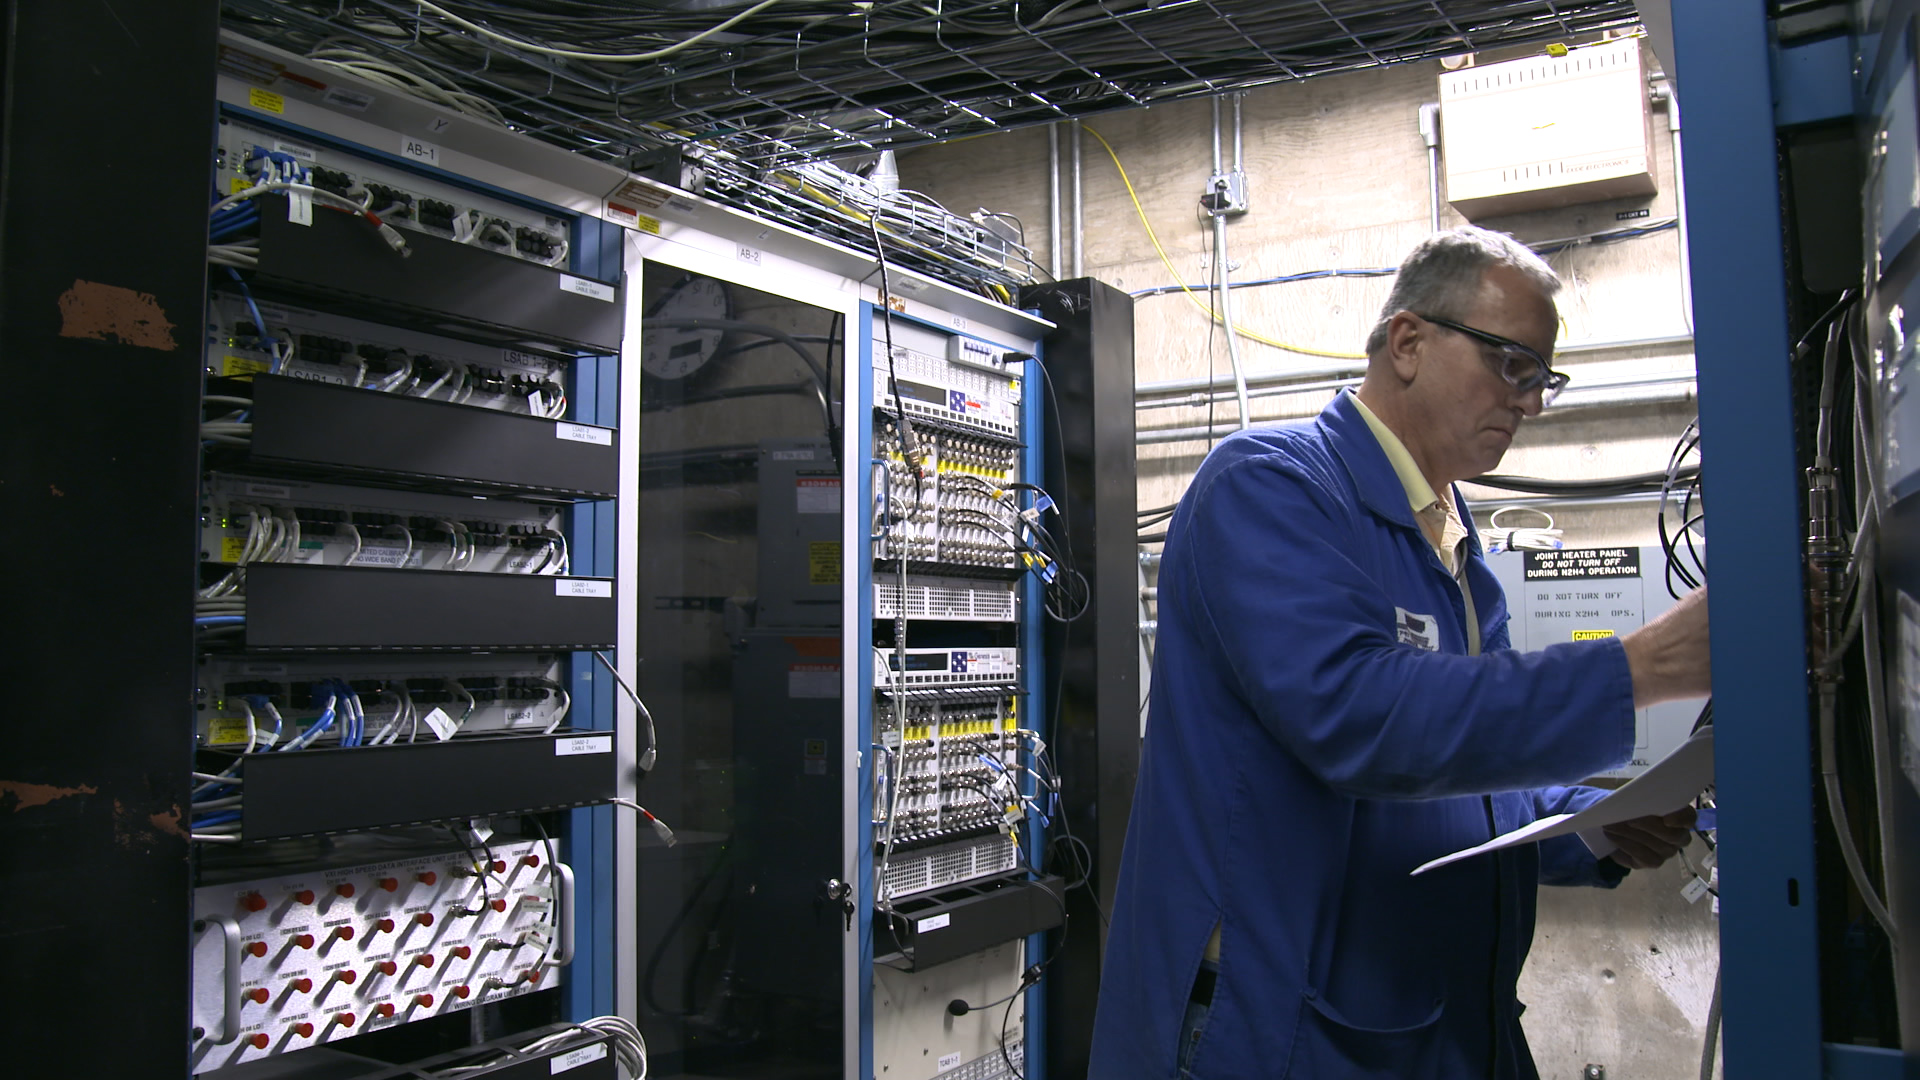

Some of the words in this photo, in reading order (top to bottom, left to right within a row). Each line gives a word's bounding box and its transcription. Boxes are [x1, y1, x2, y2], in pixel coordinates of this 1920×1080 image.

[434, 119, 448, 130] Y
[406, 141, 434, 160] AB-1
[740, 248, 759, 262] AB-2
[503, 350, 528, 366] LSAB
[1535, 552, 1559, 561] JOINT
[1563, 551, 1596, 560] HEATER
[1600, 550, 1628, 558] PANEL
[1542, 561, 1554, 569] DO
[1557, 560, 1574, 568] NOT
[1578, 559, 1601, 567] TURN
[1604, 558, 1621, 566] OFF
[1527, 570, 1558, 578] DURING
[1588, 566, 1637, 576] OPERATION
[1576, 592, 1600, 600] TURN
[1575, 632, 1612, 641] CAUTION
[397, 859, 430, 868] INTERFACE
[454, 1000, 476, 1010] WIRING
[476, 992, 502, 1004] DIAGRAM
